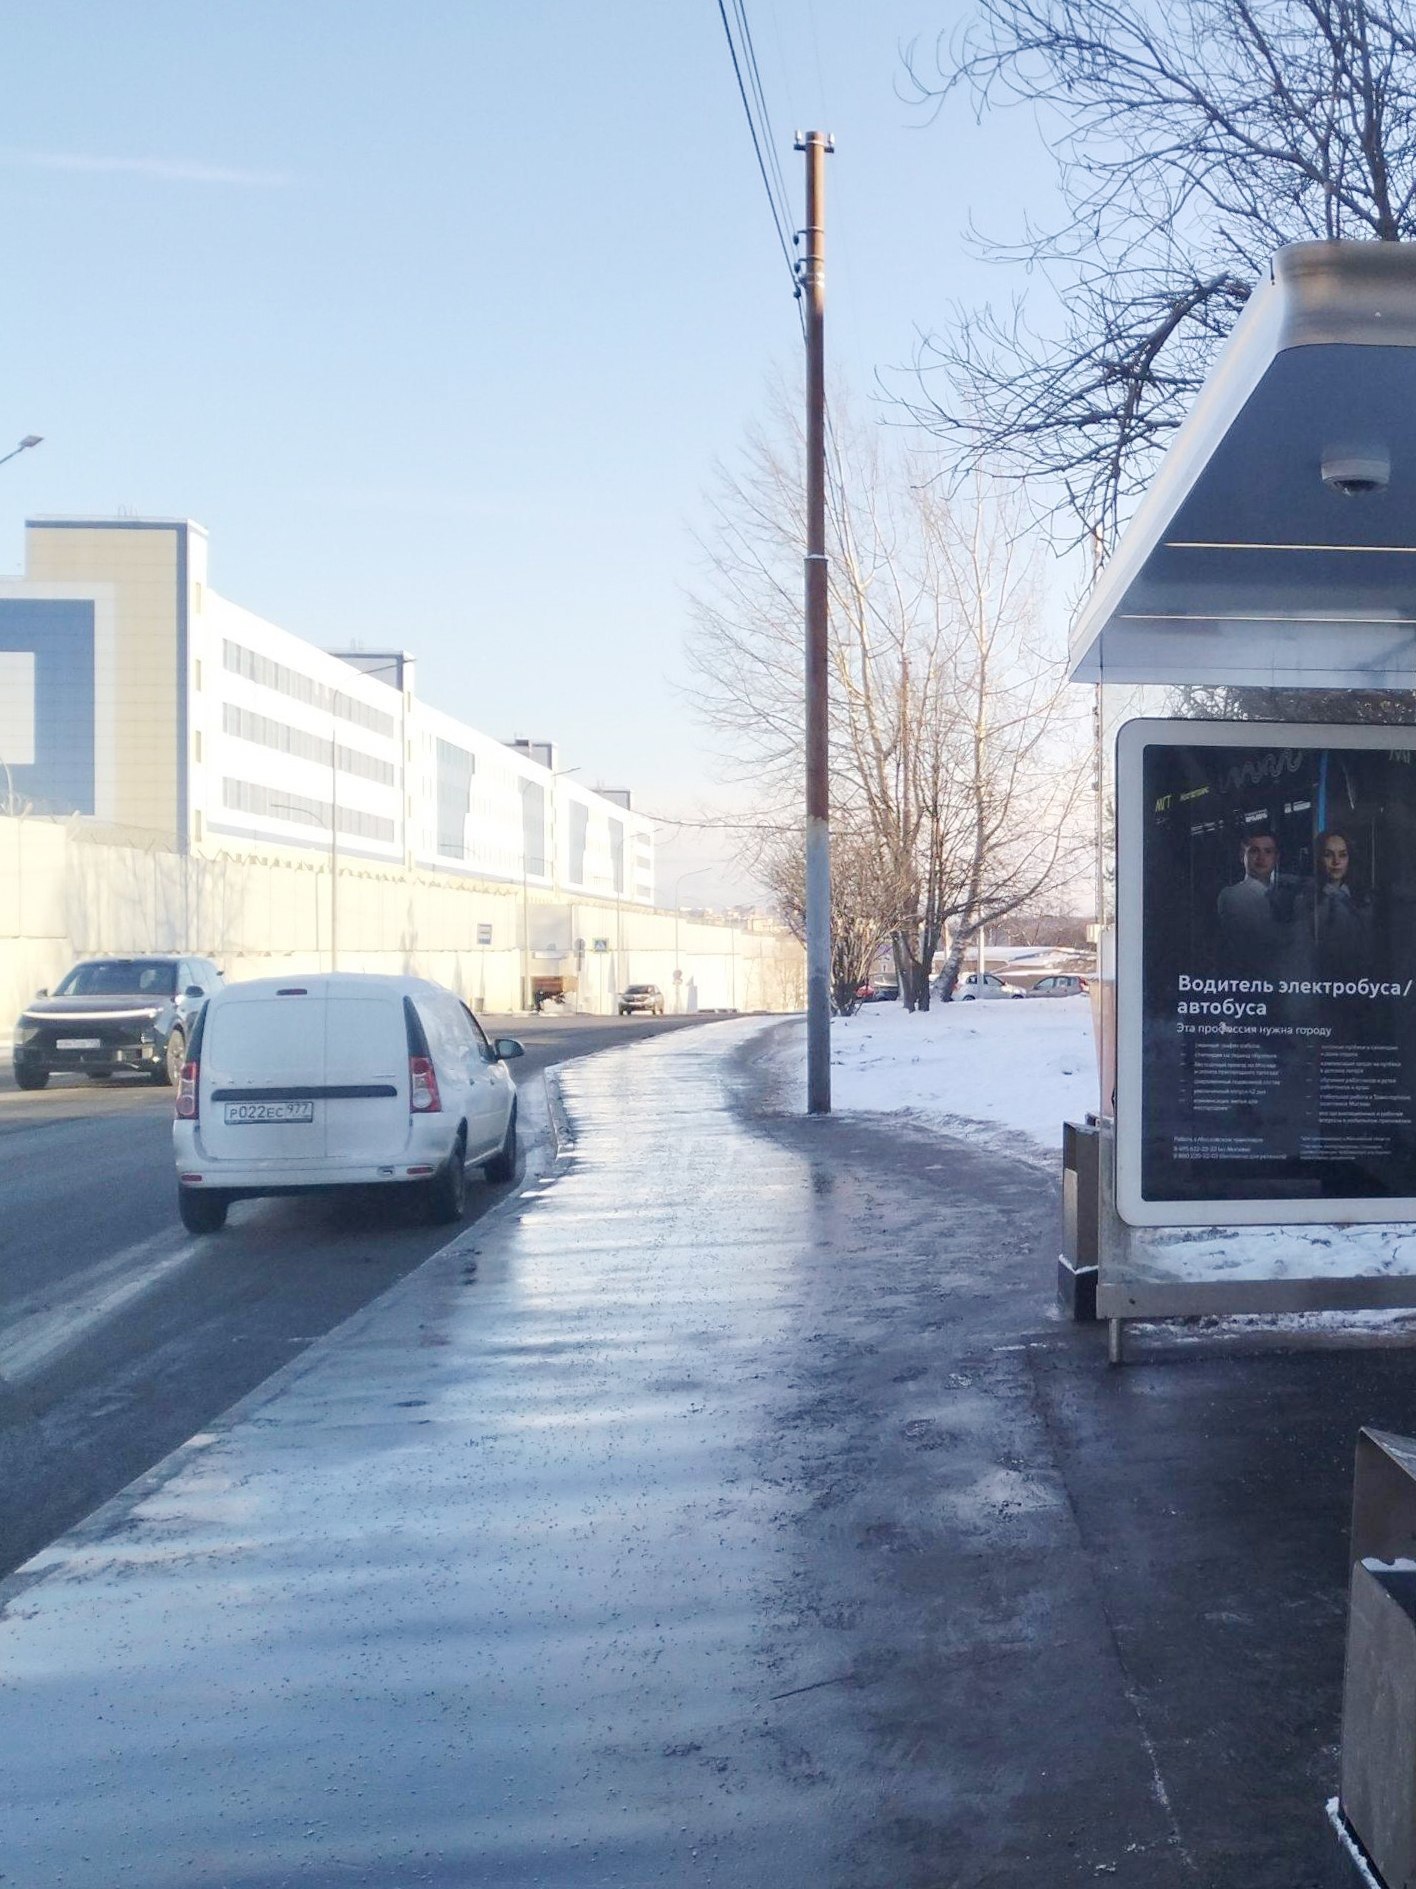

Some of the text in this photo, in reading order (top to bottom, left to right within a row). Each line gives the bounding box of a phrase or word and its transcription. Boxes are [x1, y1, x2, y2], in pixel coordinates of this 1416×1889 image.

[1178, 974, 1274, 995] Водитель
[1177, 998, 1267, 1019] автобуса
[1176, 1022, 1196, 1033] Эта
[1259, 1026, 1293, 1036] нужна
[1295, 1026, 1332, 1037] городу
